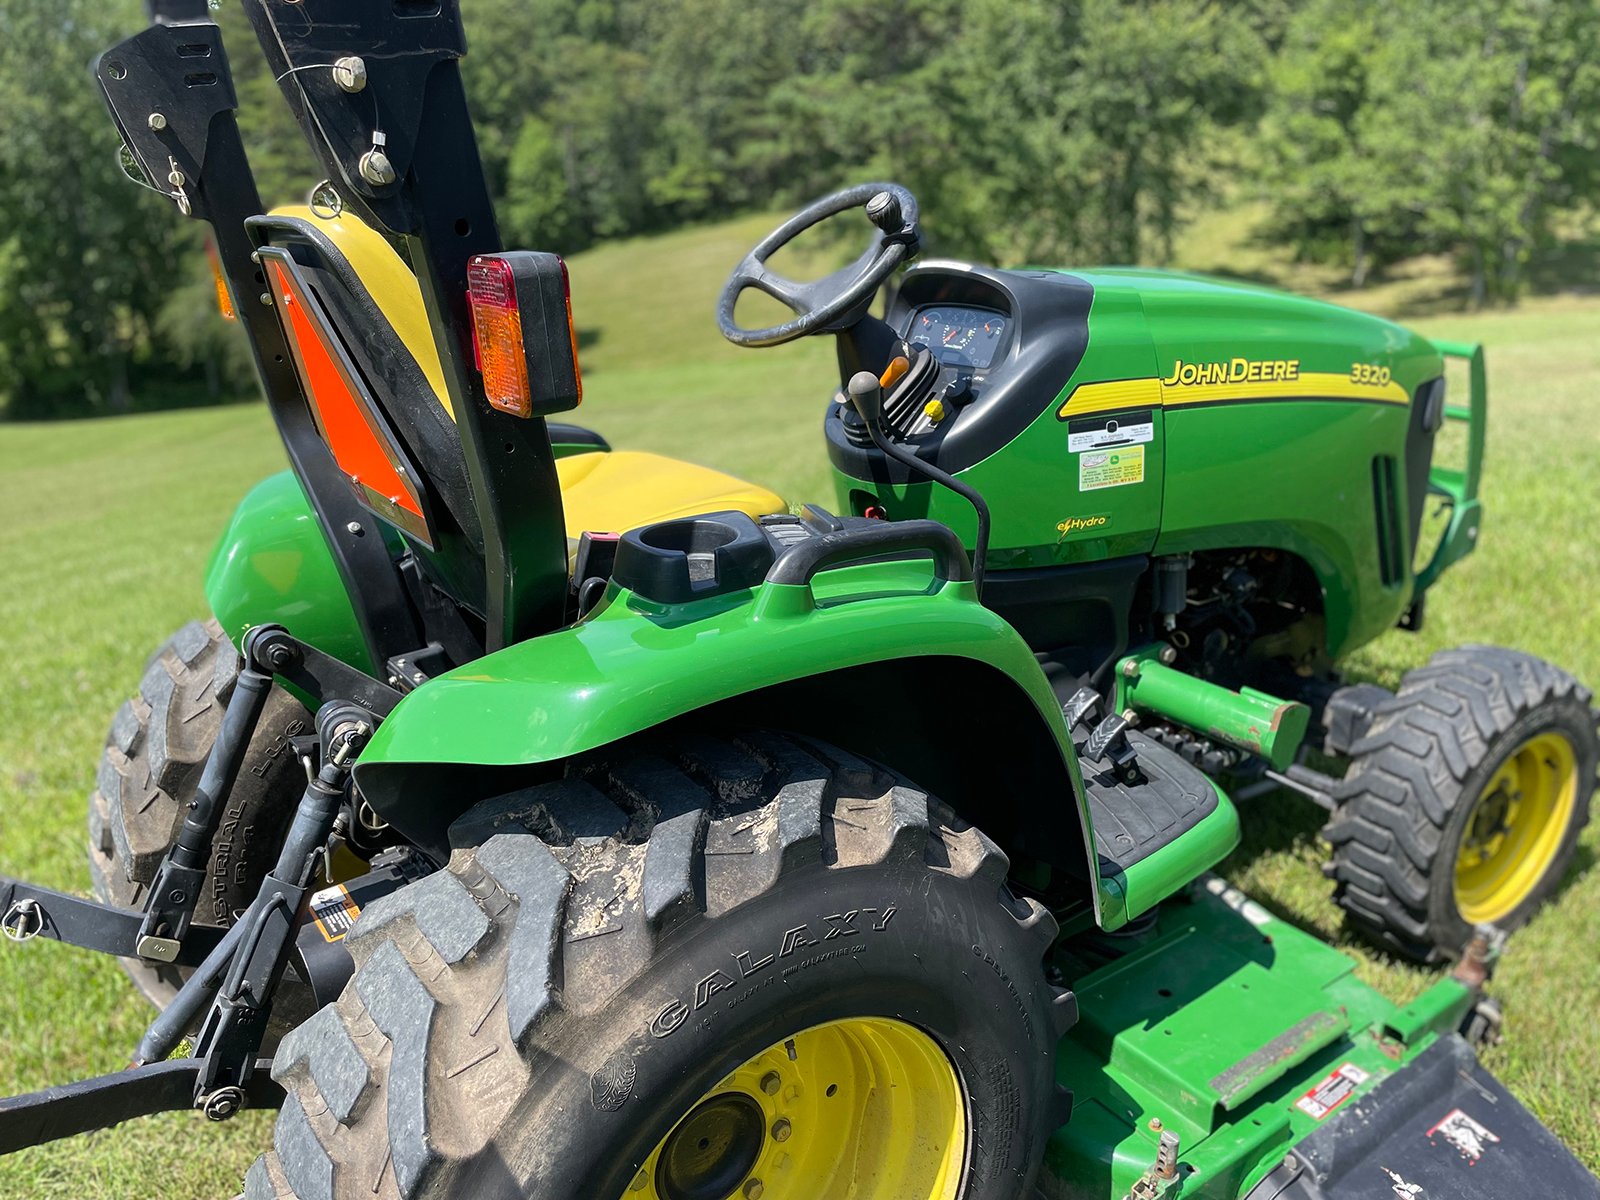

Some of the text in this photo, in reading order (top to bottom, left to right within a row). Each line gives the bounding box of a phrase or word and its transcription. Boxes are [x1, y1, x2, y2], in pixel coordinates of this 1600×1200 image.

[1163, 357, 1299, 386] JOHN DEERE
[1350, 362, 1391, 387] 3320
[649, 906, 898, 1039] GALAXY
